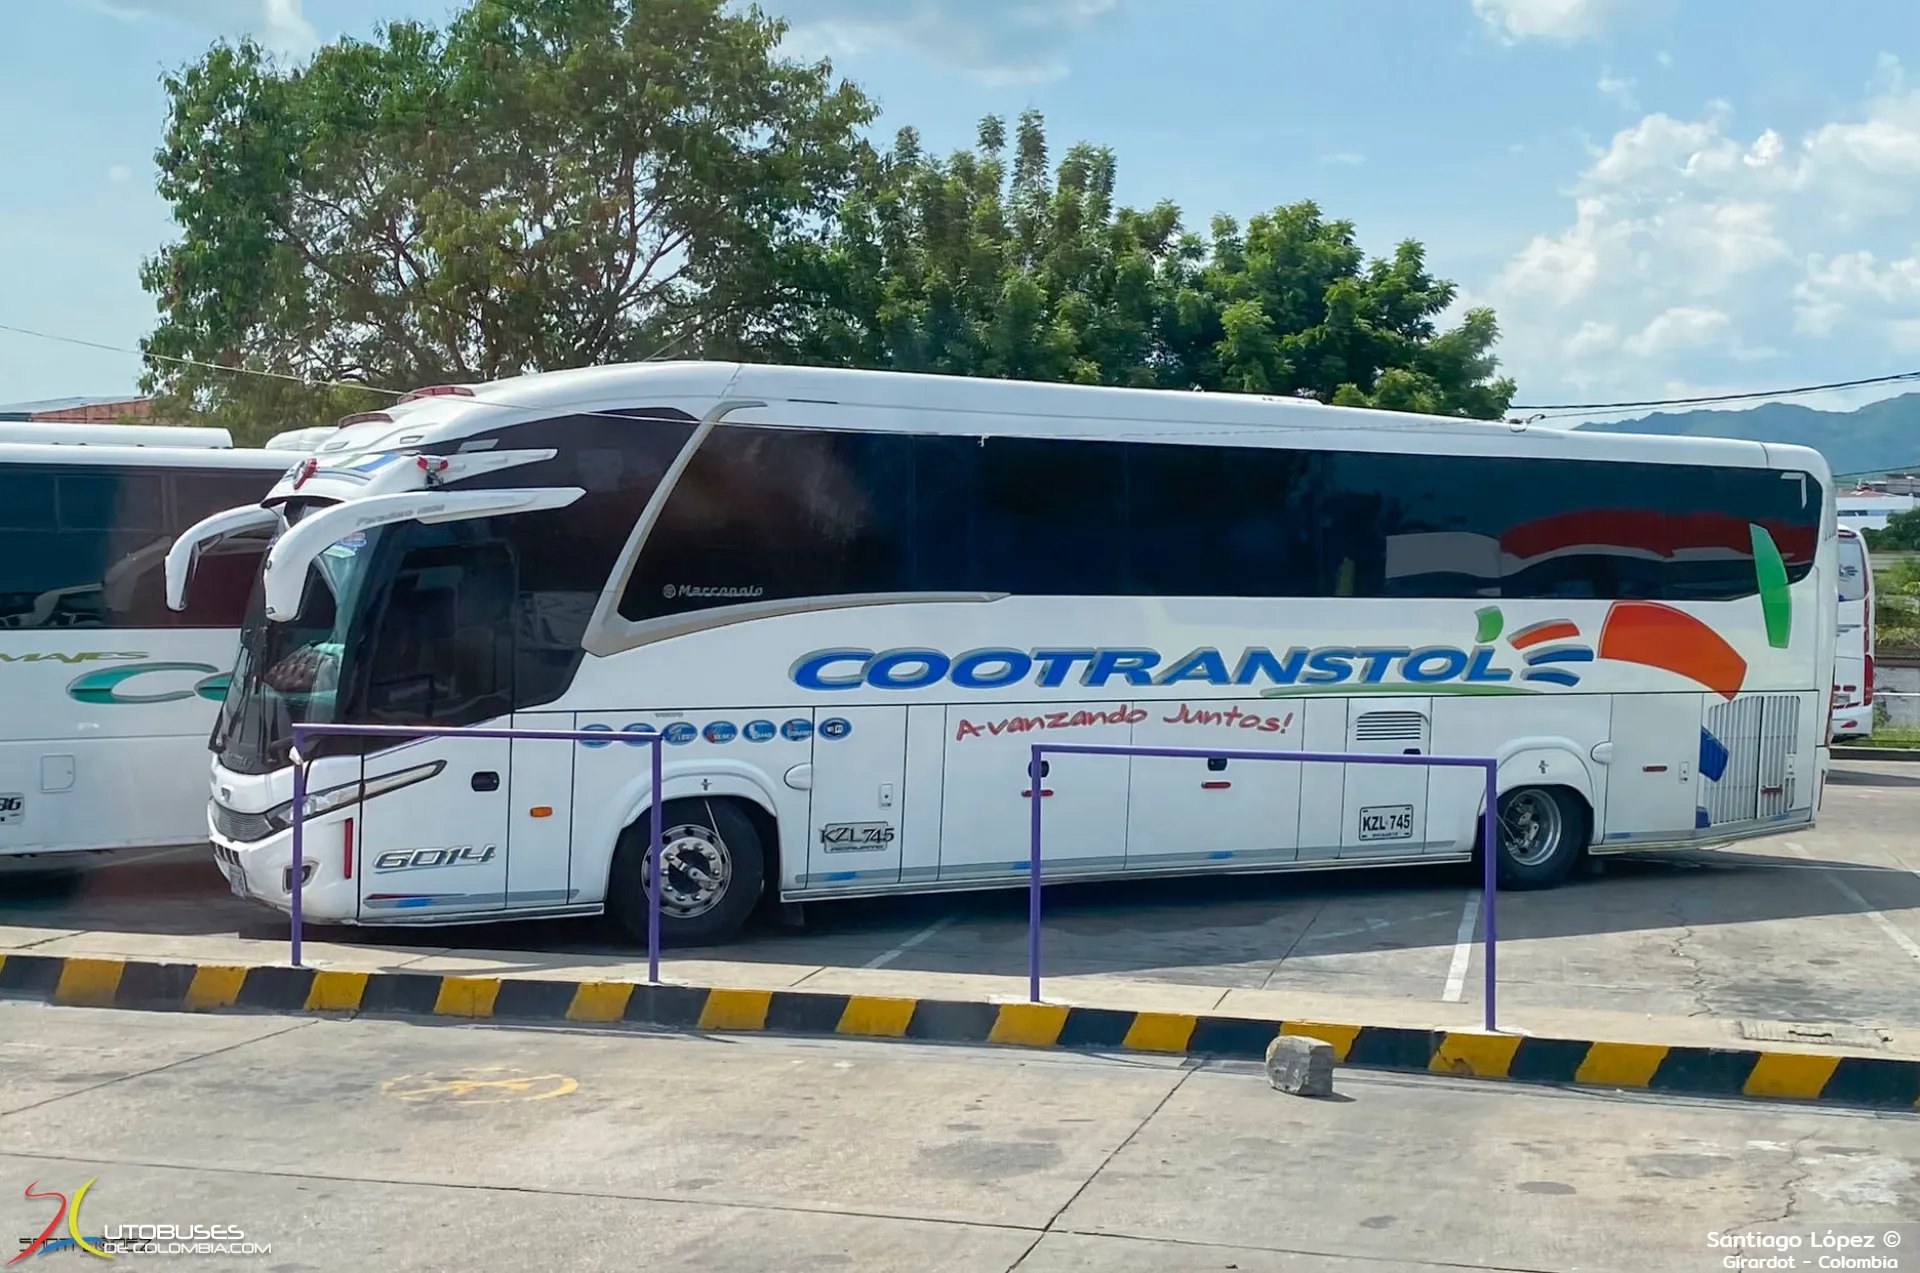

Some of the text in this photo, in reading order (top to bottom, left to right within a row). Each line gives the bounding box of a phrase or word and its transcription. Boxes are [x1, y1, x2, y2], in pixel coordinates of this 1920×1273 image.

[679, 585, 763, 597] Marcopolo
[787, 645, 1512, 691] COOTRANSTOL
[956, 703, 1294, 741] Avanzando Juntos!
[1363, 814, 1410, 831] KZL 745
[862, 827, 895, 843] 745
